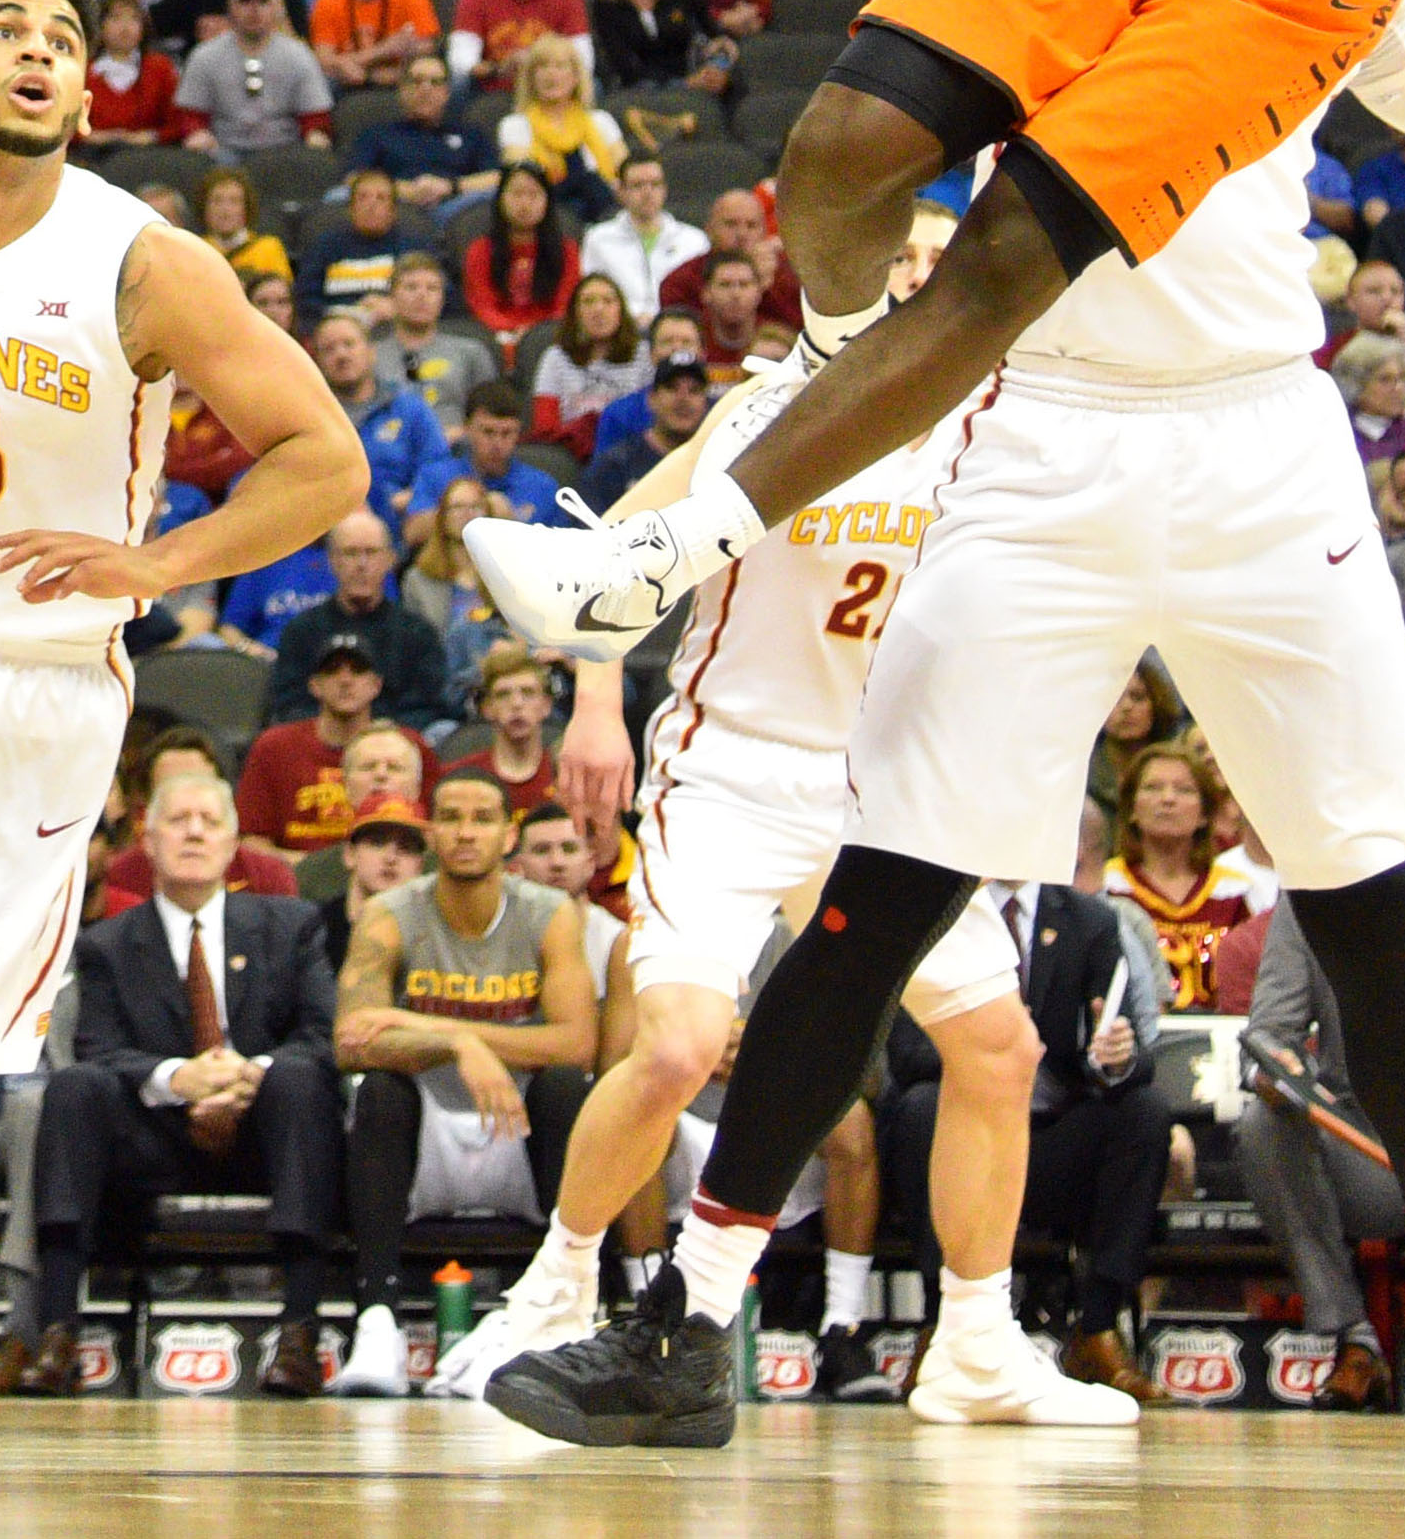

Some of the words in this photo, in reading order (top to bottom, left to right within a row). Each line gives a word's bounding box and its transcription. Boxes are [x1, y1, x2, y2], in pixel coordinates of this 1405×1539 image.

[35, 298, 71, 319] XII
[824, 560, 888, 640] 2
[170, 1351, 226, 1379] 66
[1174, 1357, 1228, 1388] 66
